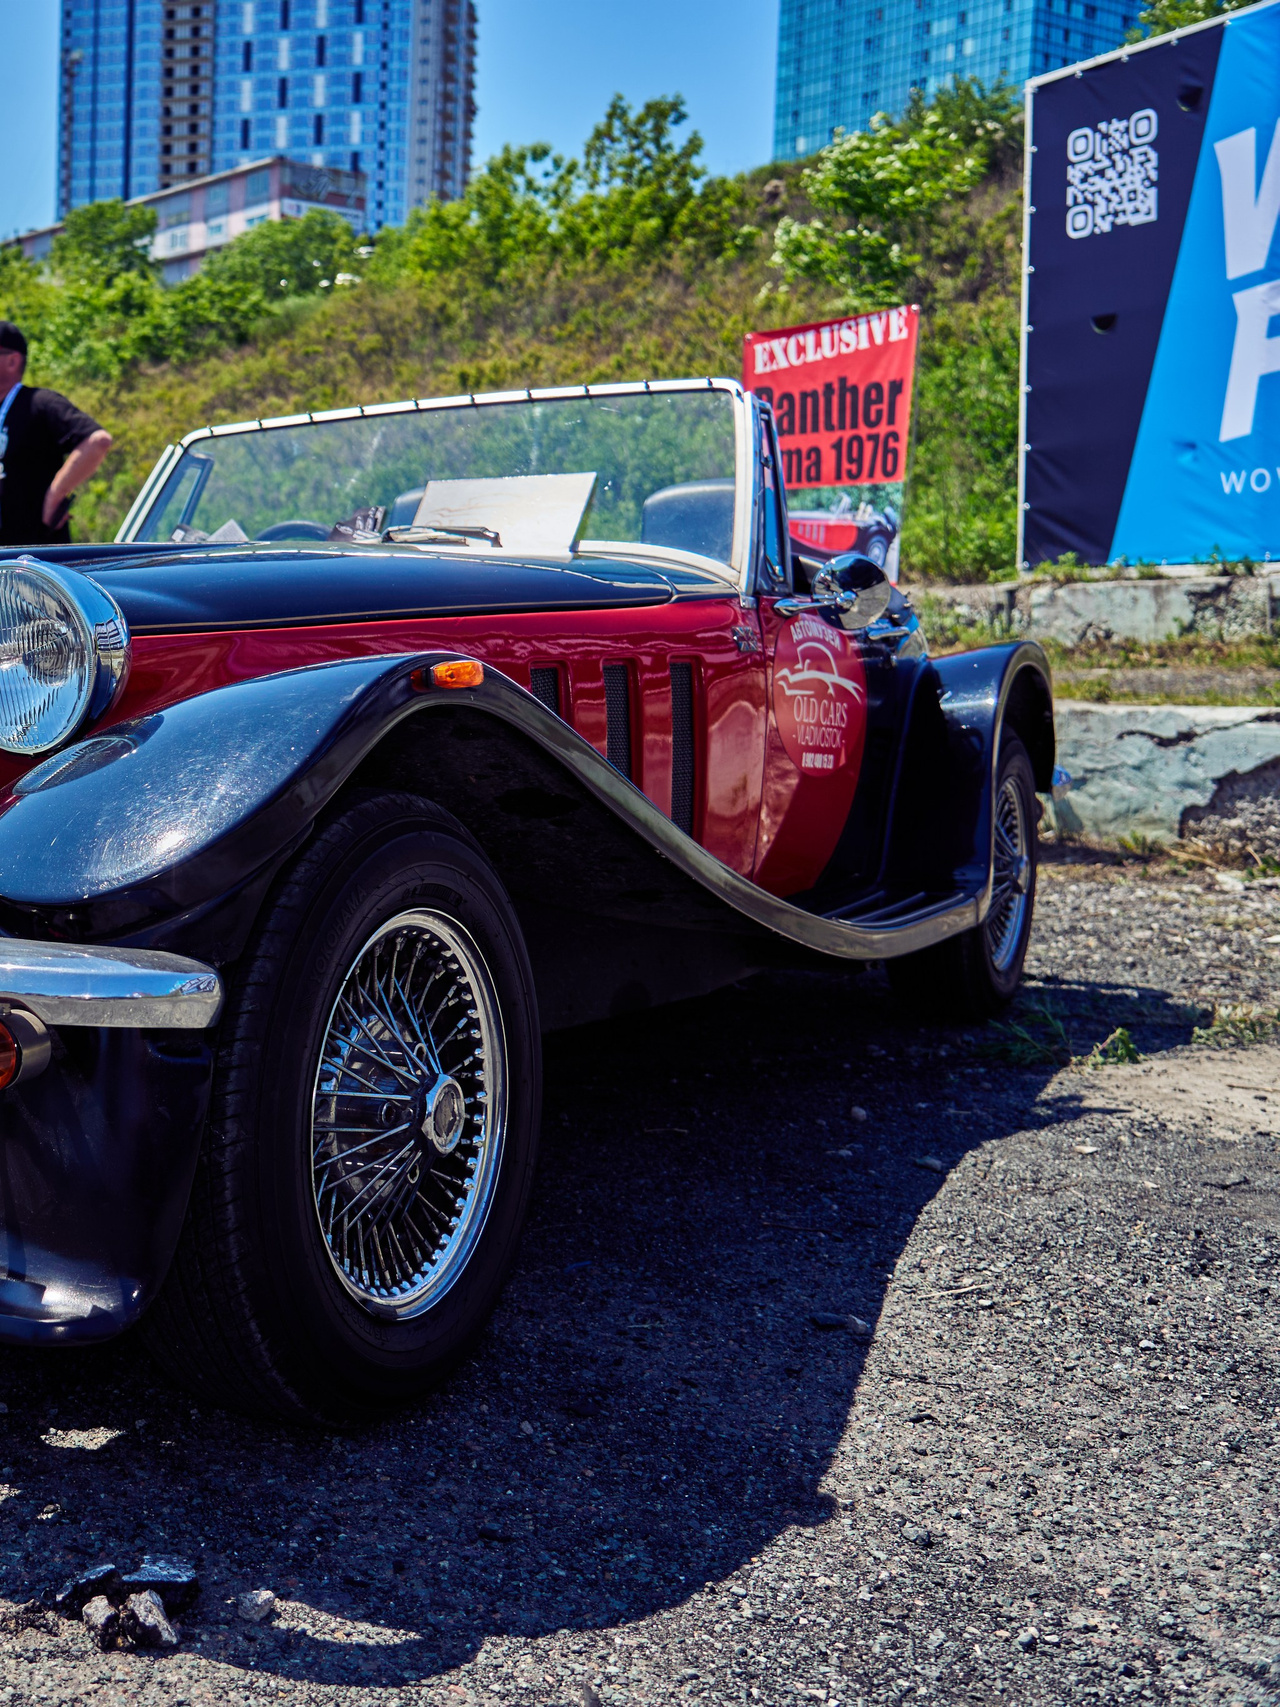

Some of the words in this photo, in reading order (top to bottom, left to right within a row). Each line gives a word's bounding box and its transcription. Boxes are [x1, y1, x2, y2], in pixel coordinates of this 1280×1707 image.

[753, 305, 908, 374] EXCLUSIVE
[783, 446, 821, 484] ma
[831, 431, 900, 482] 1976
[1220, 467, 1280, 495] WO
[790, 620, 841, 652] АВТОМУЗЕЙ
[793, 695, 818, 724] OLD
[820, 700, 848, 728] CARS
[311, 885, 367, 984] YOKOHAMA
